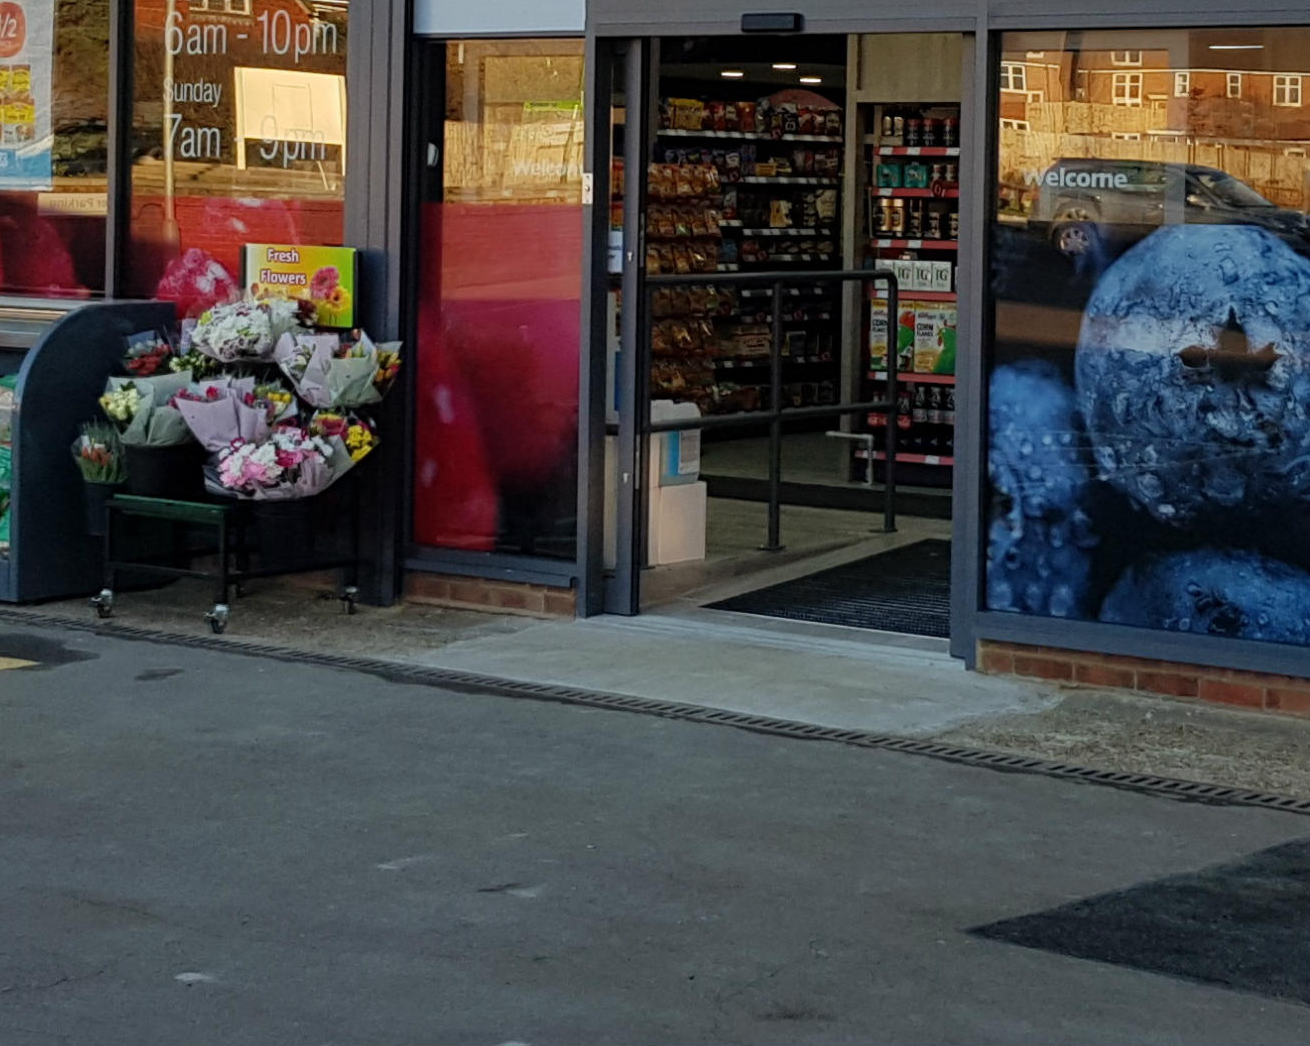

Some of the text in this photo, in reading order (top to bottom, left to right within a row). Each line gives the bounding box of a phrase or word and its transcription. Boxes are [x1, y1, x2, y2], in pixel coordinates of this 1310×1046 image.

[164, 10, 227, 55] 6am
[257, 9, 338, 62] 10pm
[163, 77, 222, 107] Sunday
[163, 113, 221, 159] 7am
[259, 115, 326, 168] 9pm
[1021, 167, 1129, 188] Welcome
[267, 249, 300, 263] Fresh
[260, 270, 307, 285] Flowers
